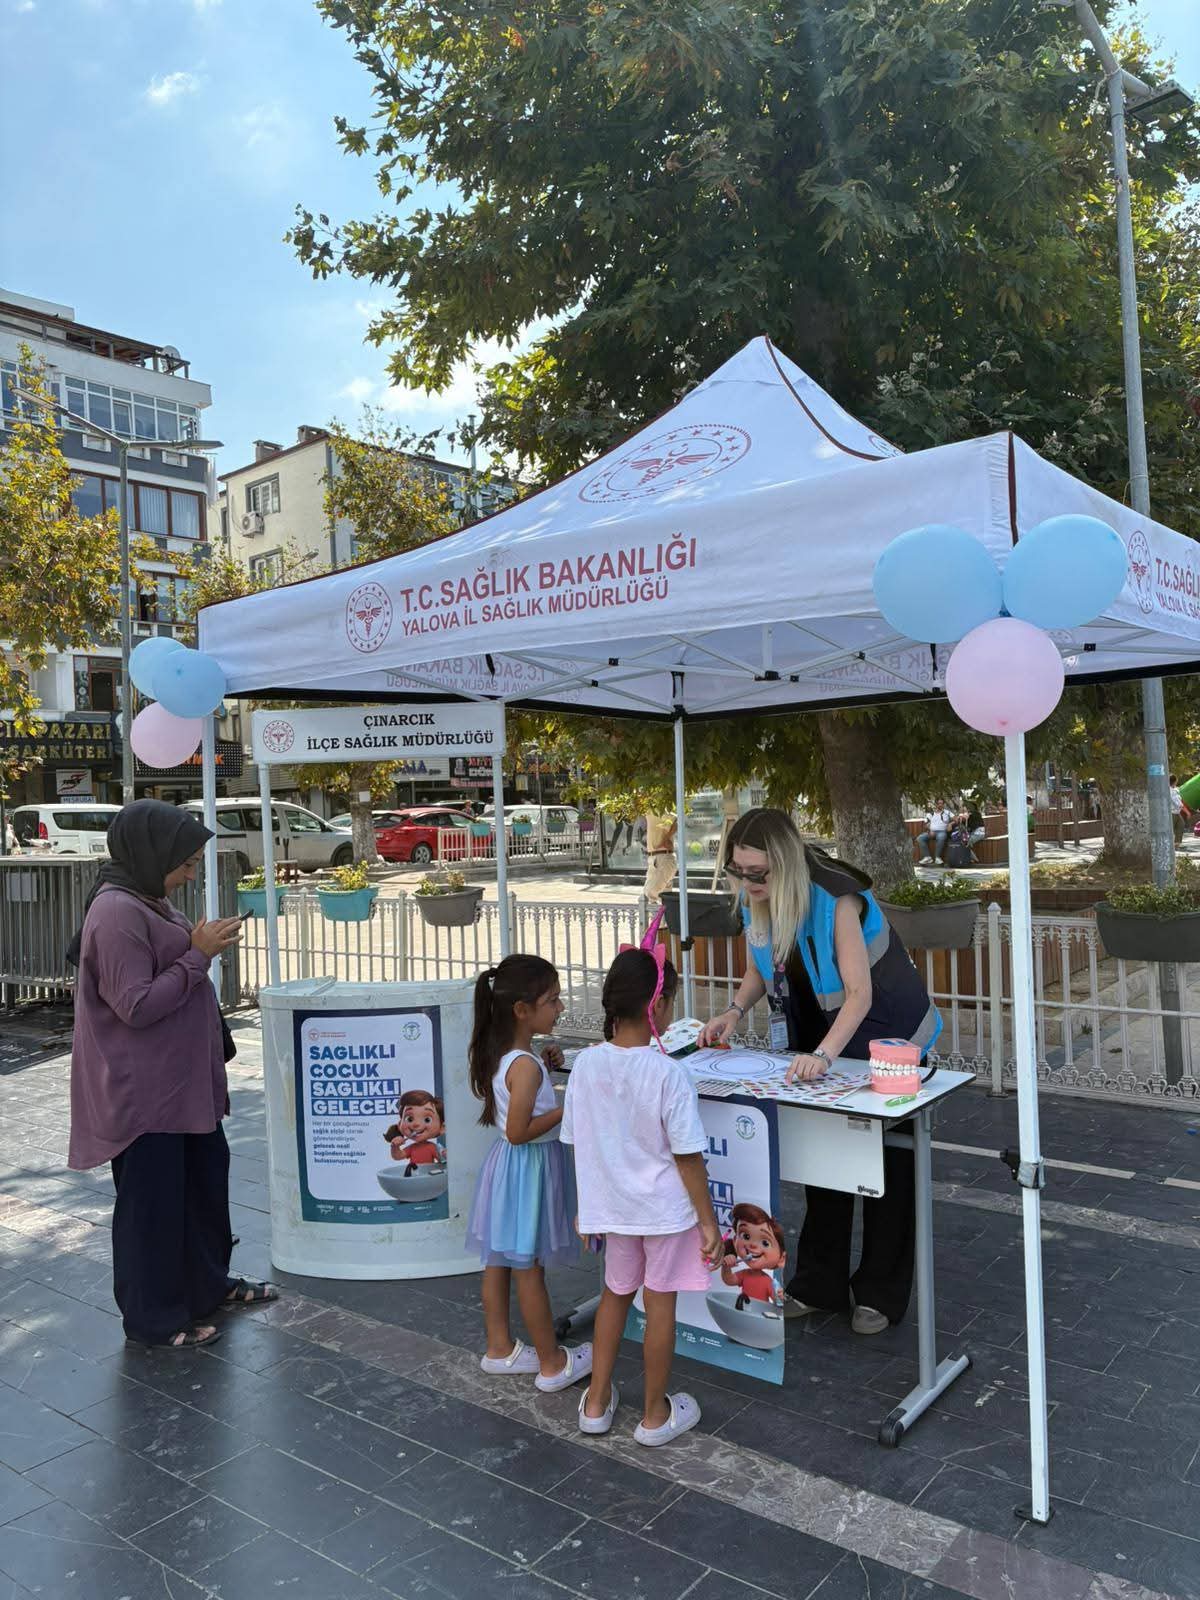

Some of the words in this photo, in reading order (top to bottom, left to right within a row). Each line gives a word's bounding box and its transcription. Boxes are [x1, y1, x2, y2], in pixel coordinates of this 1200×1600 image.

[400, 565, 531, 613] T.C.SAĞLIK
[538, 532, 697, 590] BAKANLIĞI
[1155, 557, 1200, 599] T.C.SAĞLI
[402, 611, 460, 636] YALOVA
[464, 604, 478, 626] İL
[481, 597, 544, 622] SAĞLIK
[548, 575, 668, 614] MÜDÜRLÜĞÜ
[363, 713, 435, 730] ÇINARCIK
[307, 736, 340, 752] İLÇE
[344, 733, 398, 749] SAĞLIK
[402, 730, 494, 747] MÜDÜRLÜĞÜ
[313, 1099, 399, 1115] GELECEK
